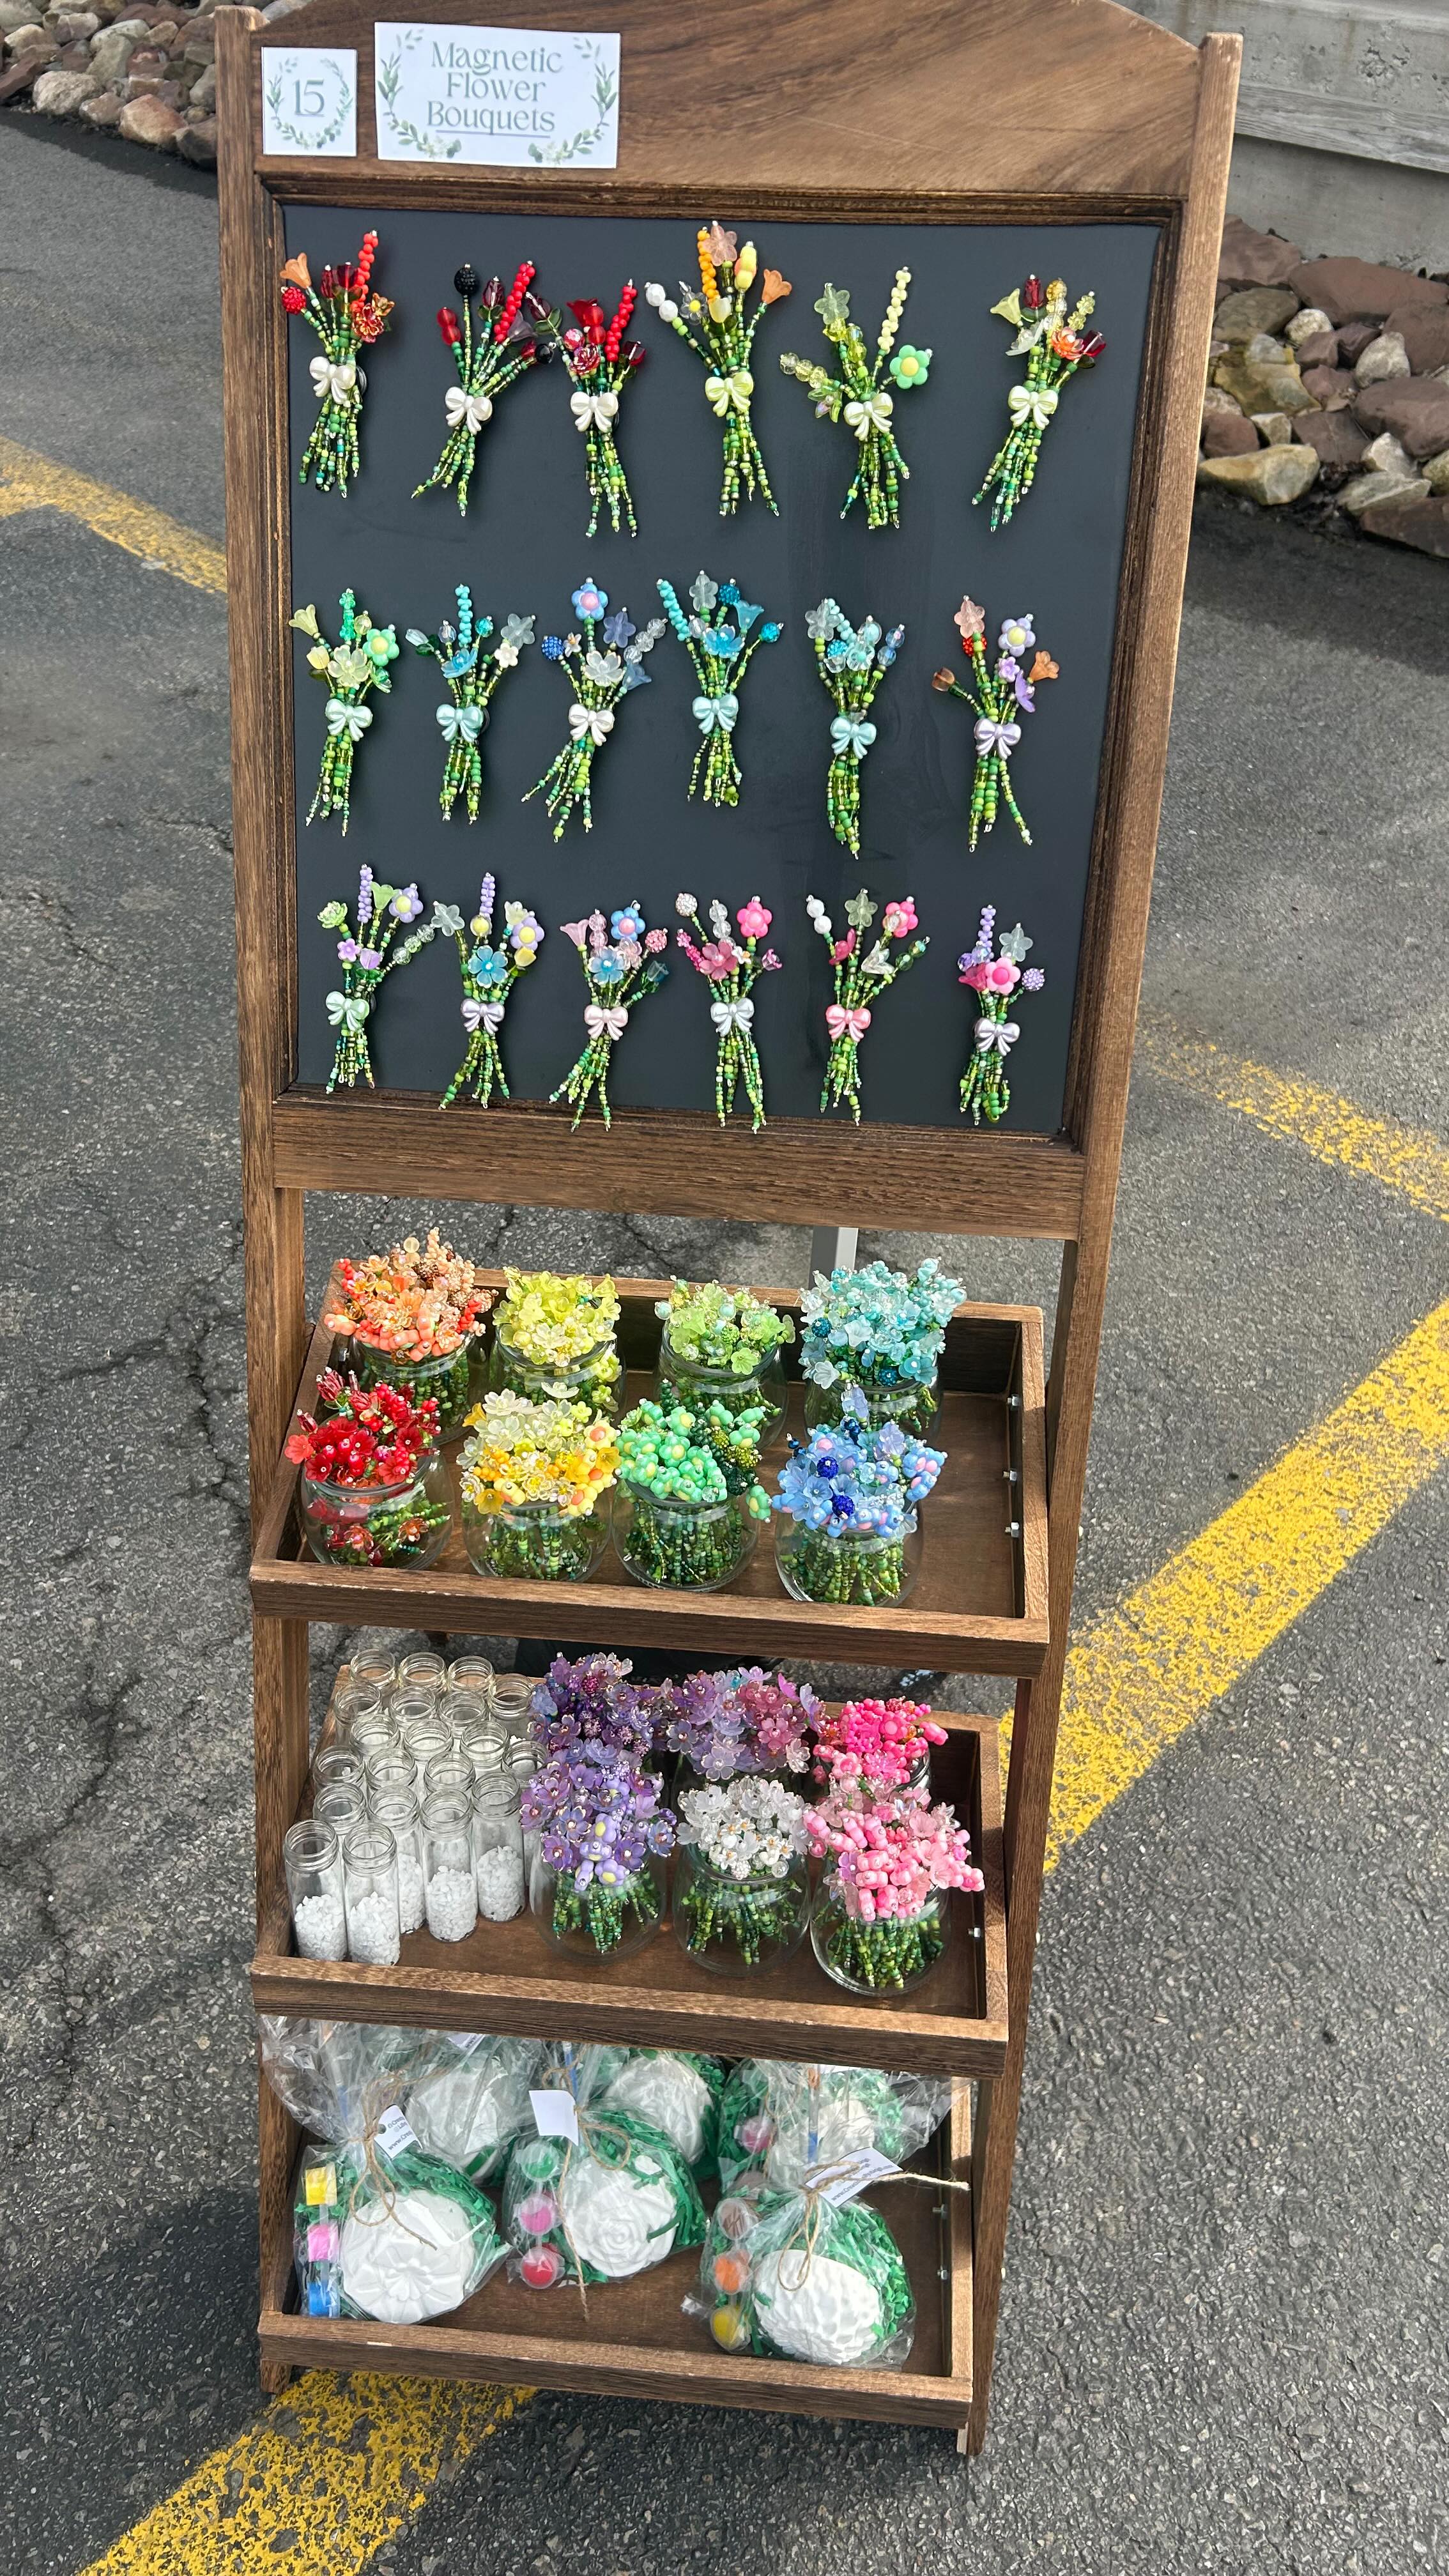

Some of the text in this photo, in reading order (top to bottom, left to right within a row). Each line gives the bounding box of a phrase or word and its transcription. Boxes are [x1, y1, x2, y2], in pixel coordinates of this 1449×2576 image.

[431, 41, 564, 75] Magnetic
[293, 79, 325, 116] 15
[447, 72, 546, 102] Flower
[427, 100, 555, 135] Bouquets
